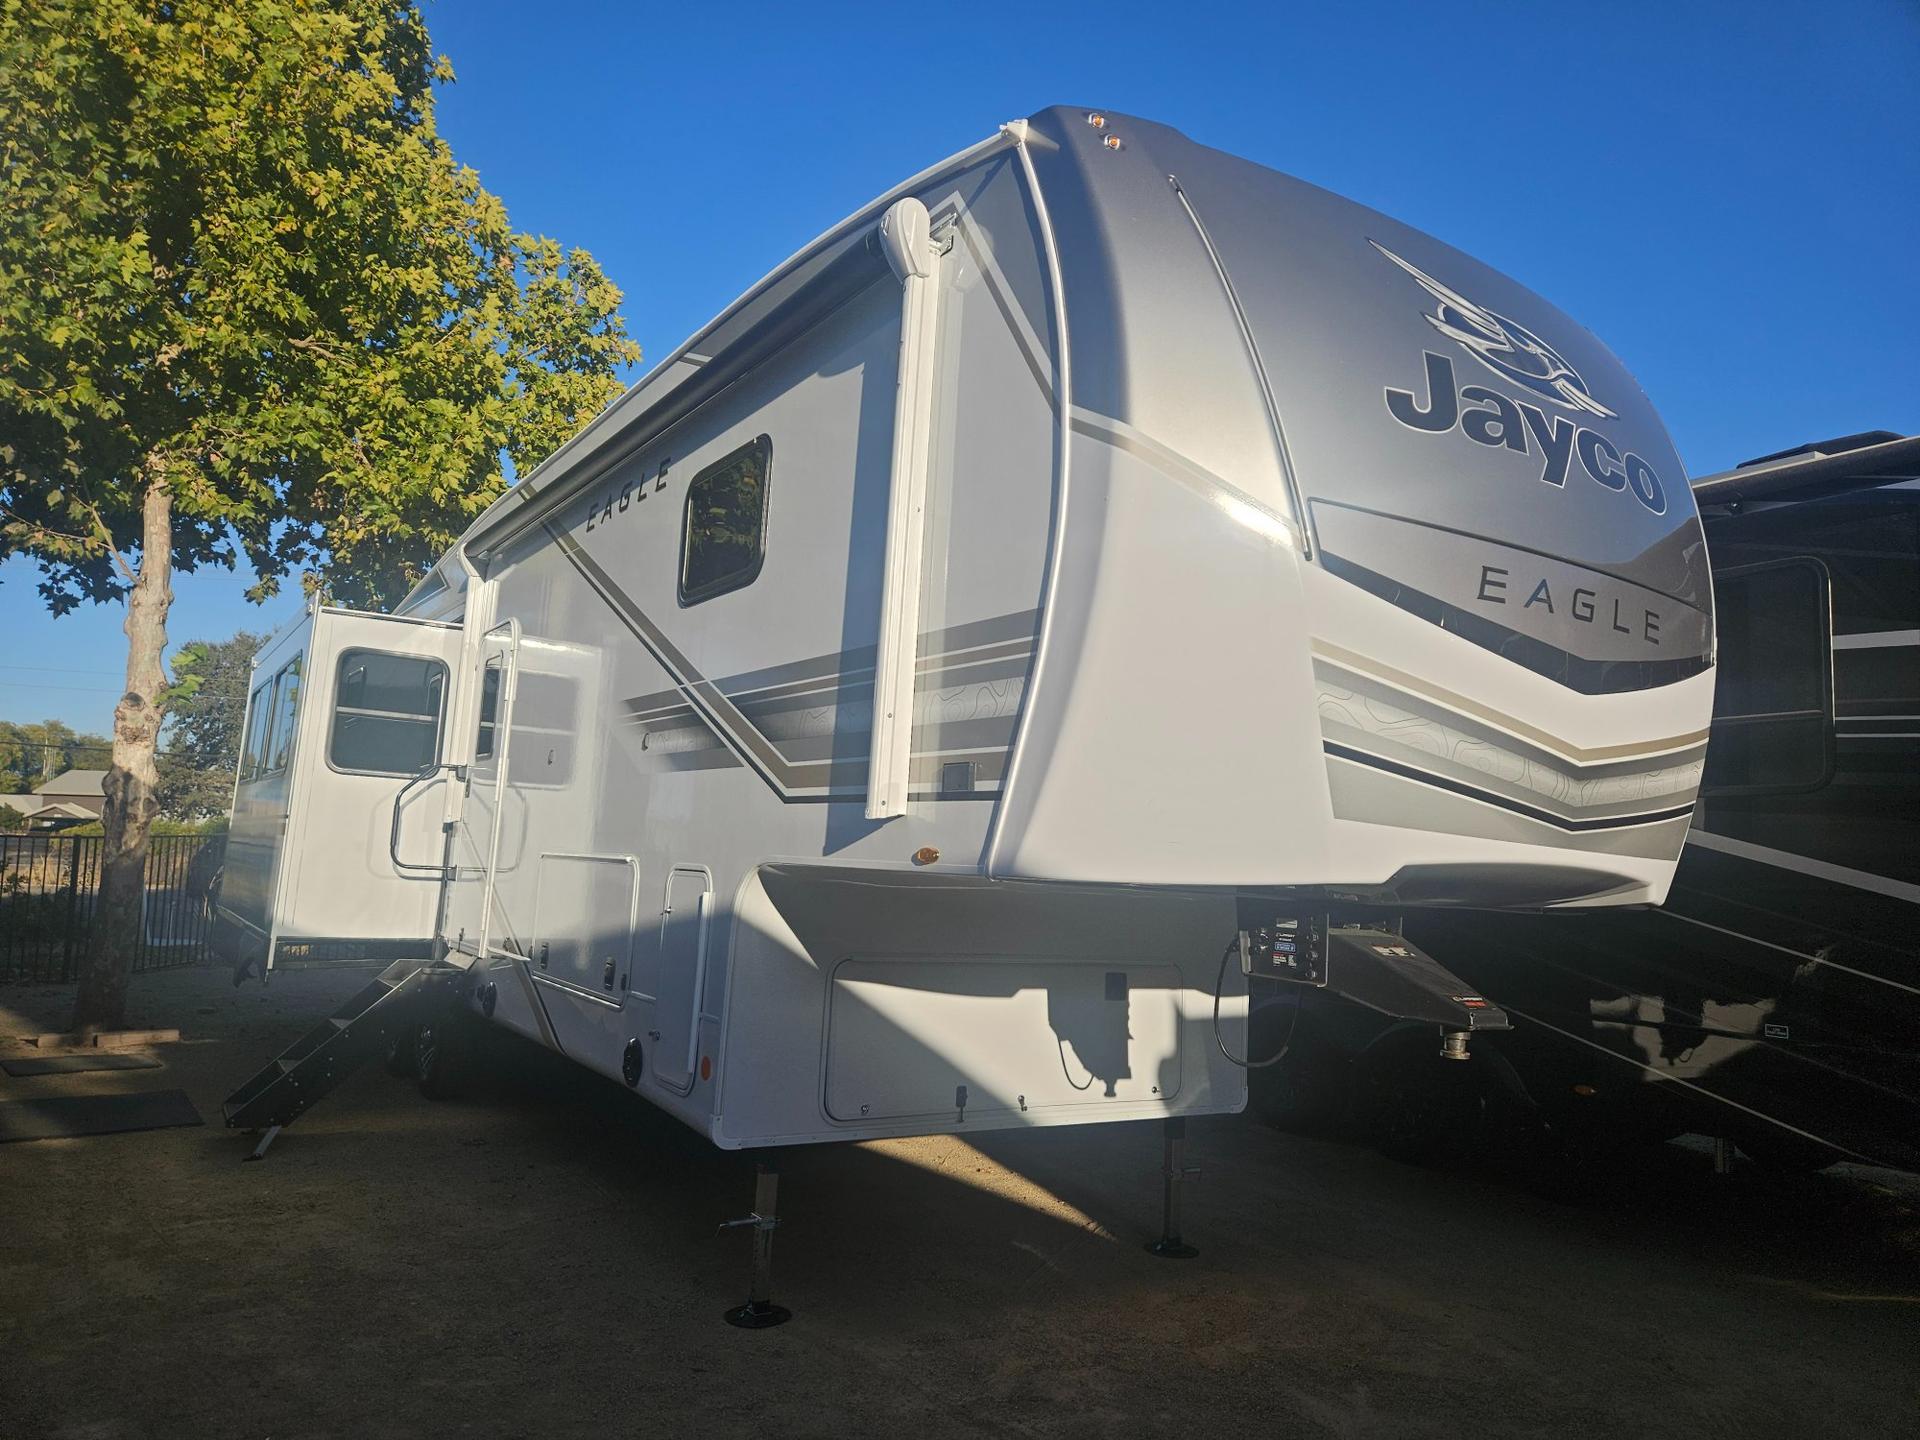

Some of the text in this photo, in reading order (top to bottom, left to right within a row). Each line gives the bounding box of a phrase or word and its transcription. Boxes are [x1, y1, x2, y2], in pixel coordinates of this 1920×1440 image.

[1384, 349, 1667, 516] Jayco
[586, 457, 671, 533] EAGLE
[1477, 565, 1660, 645] EAGLE
